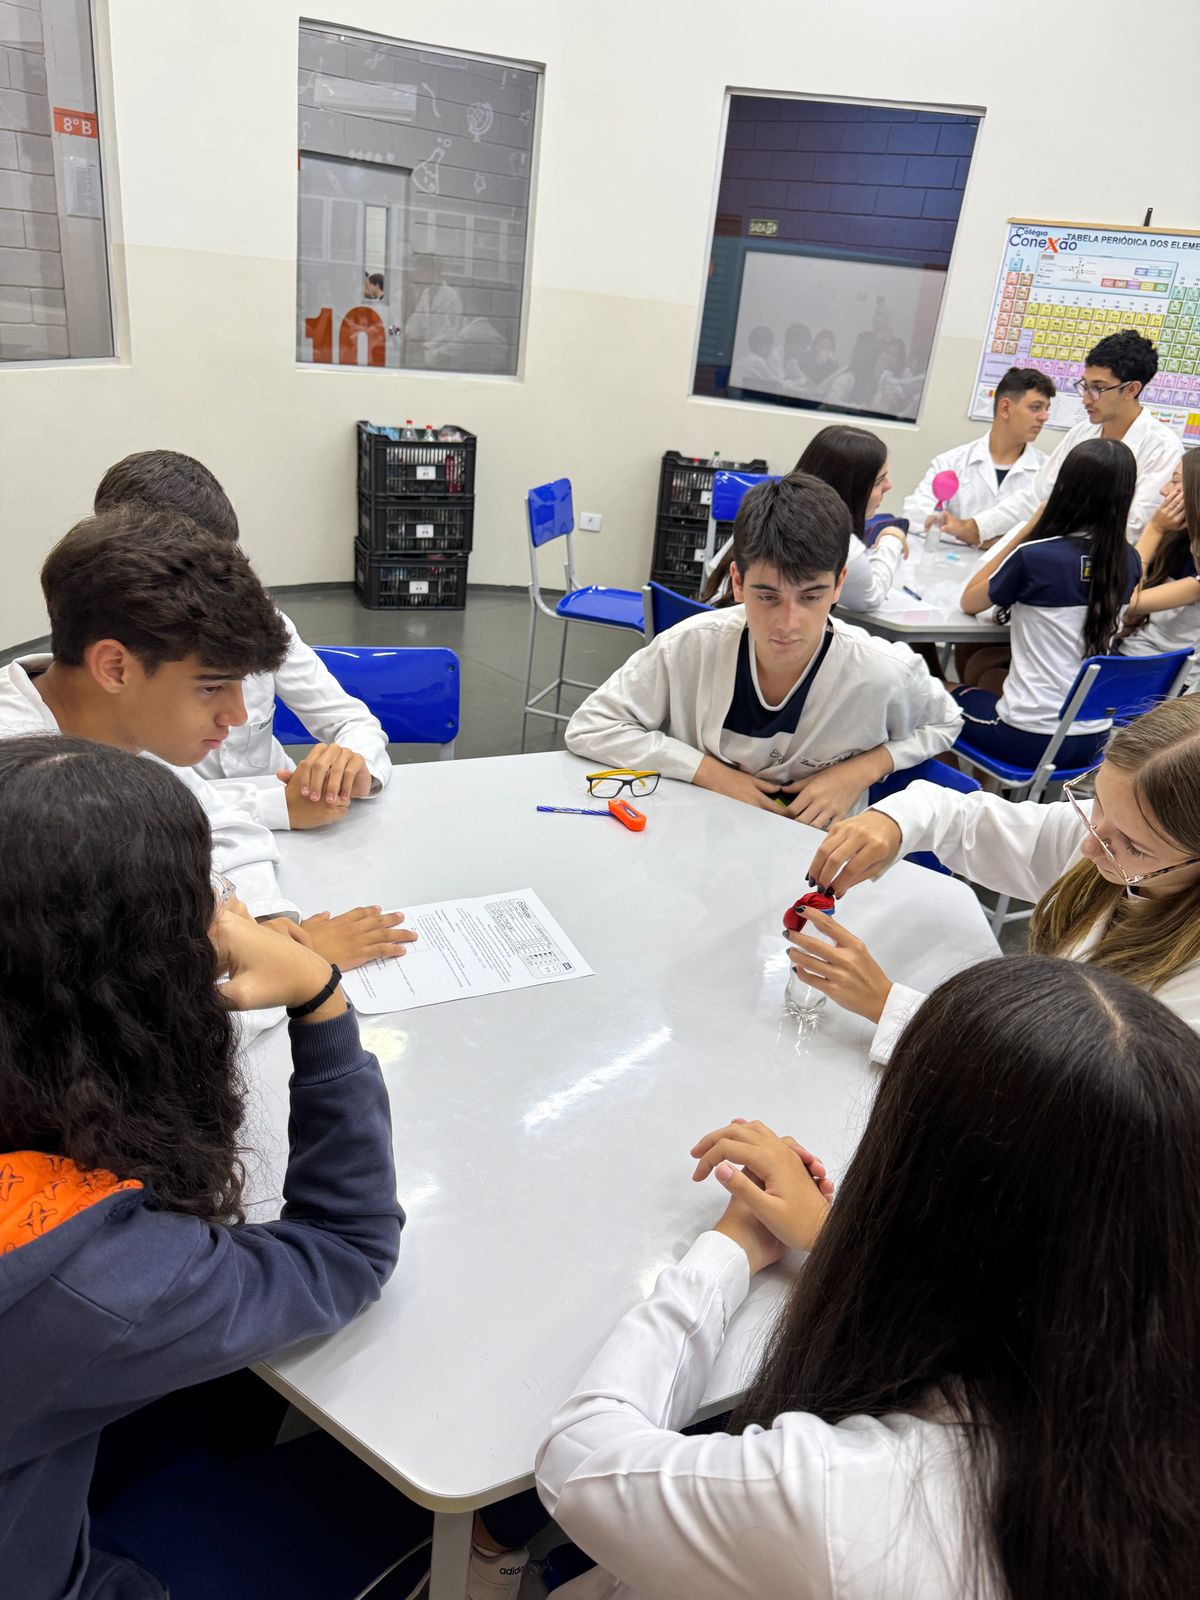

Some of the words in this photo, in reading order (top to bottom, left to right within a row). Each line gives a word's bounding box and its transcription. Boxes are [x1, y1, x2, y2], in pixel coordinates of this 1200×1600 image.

[81, 120, 92, 135] B
[1016, 227, 1048, 237] Colégio
[1066, 233, 1099, 243] TABELA
[1100, 235, 1148, 247] PERIÓDICA
[1149, 239, 1169, 248] DOS
